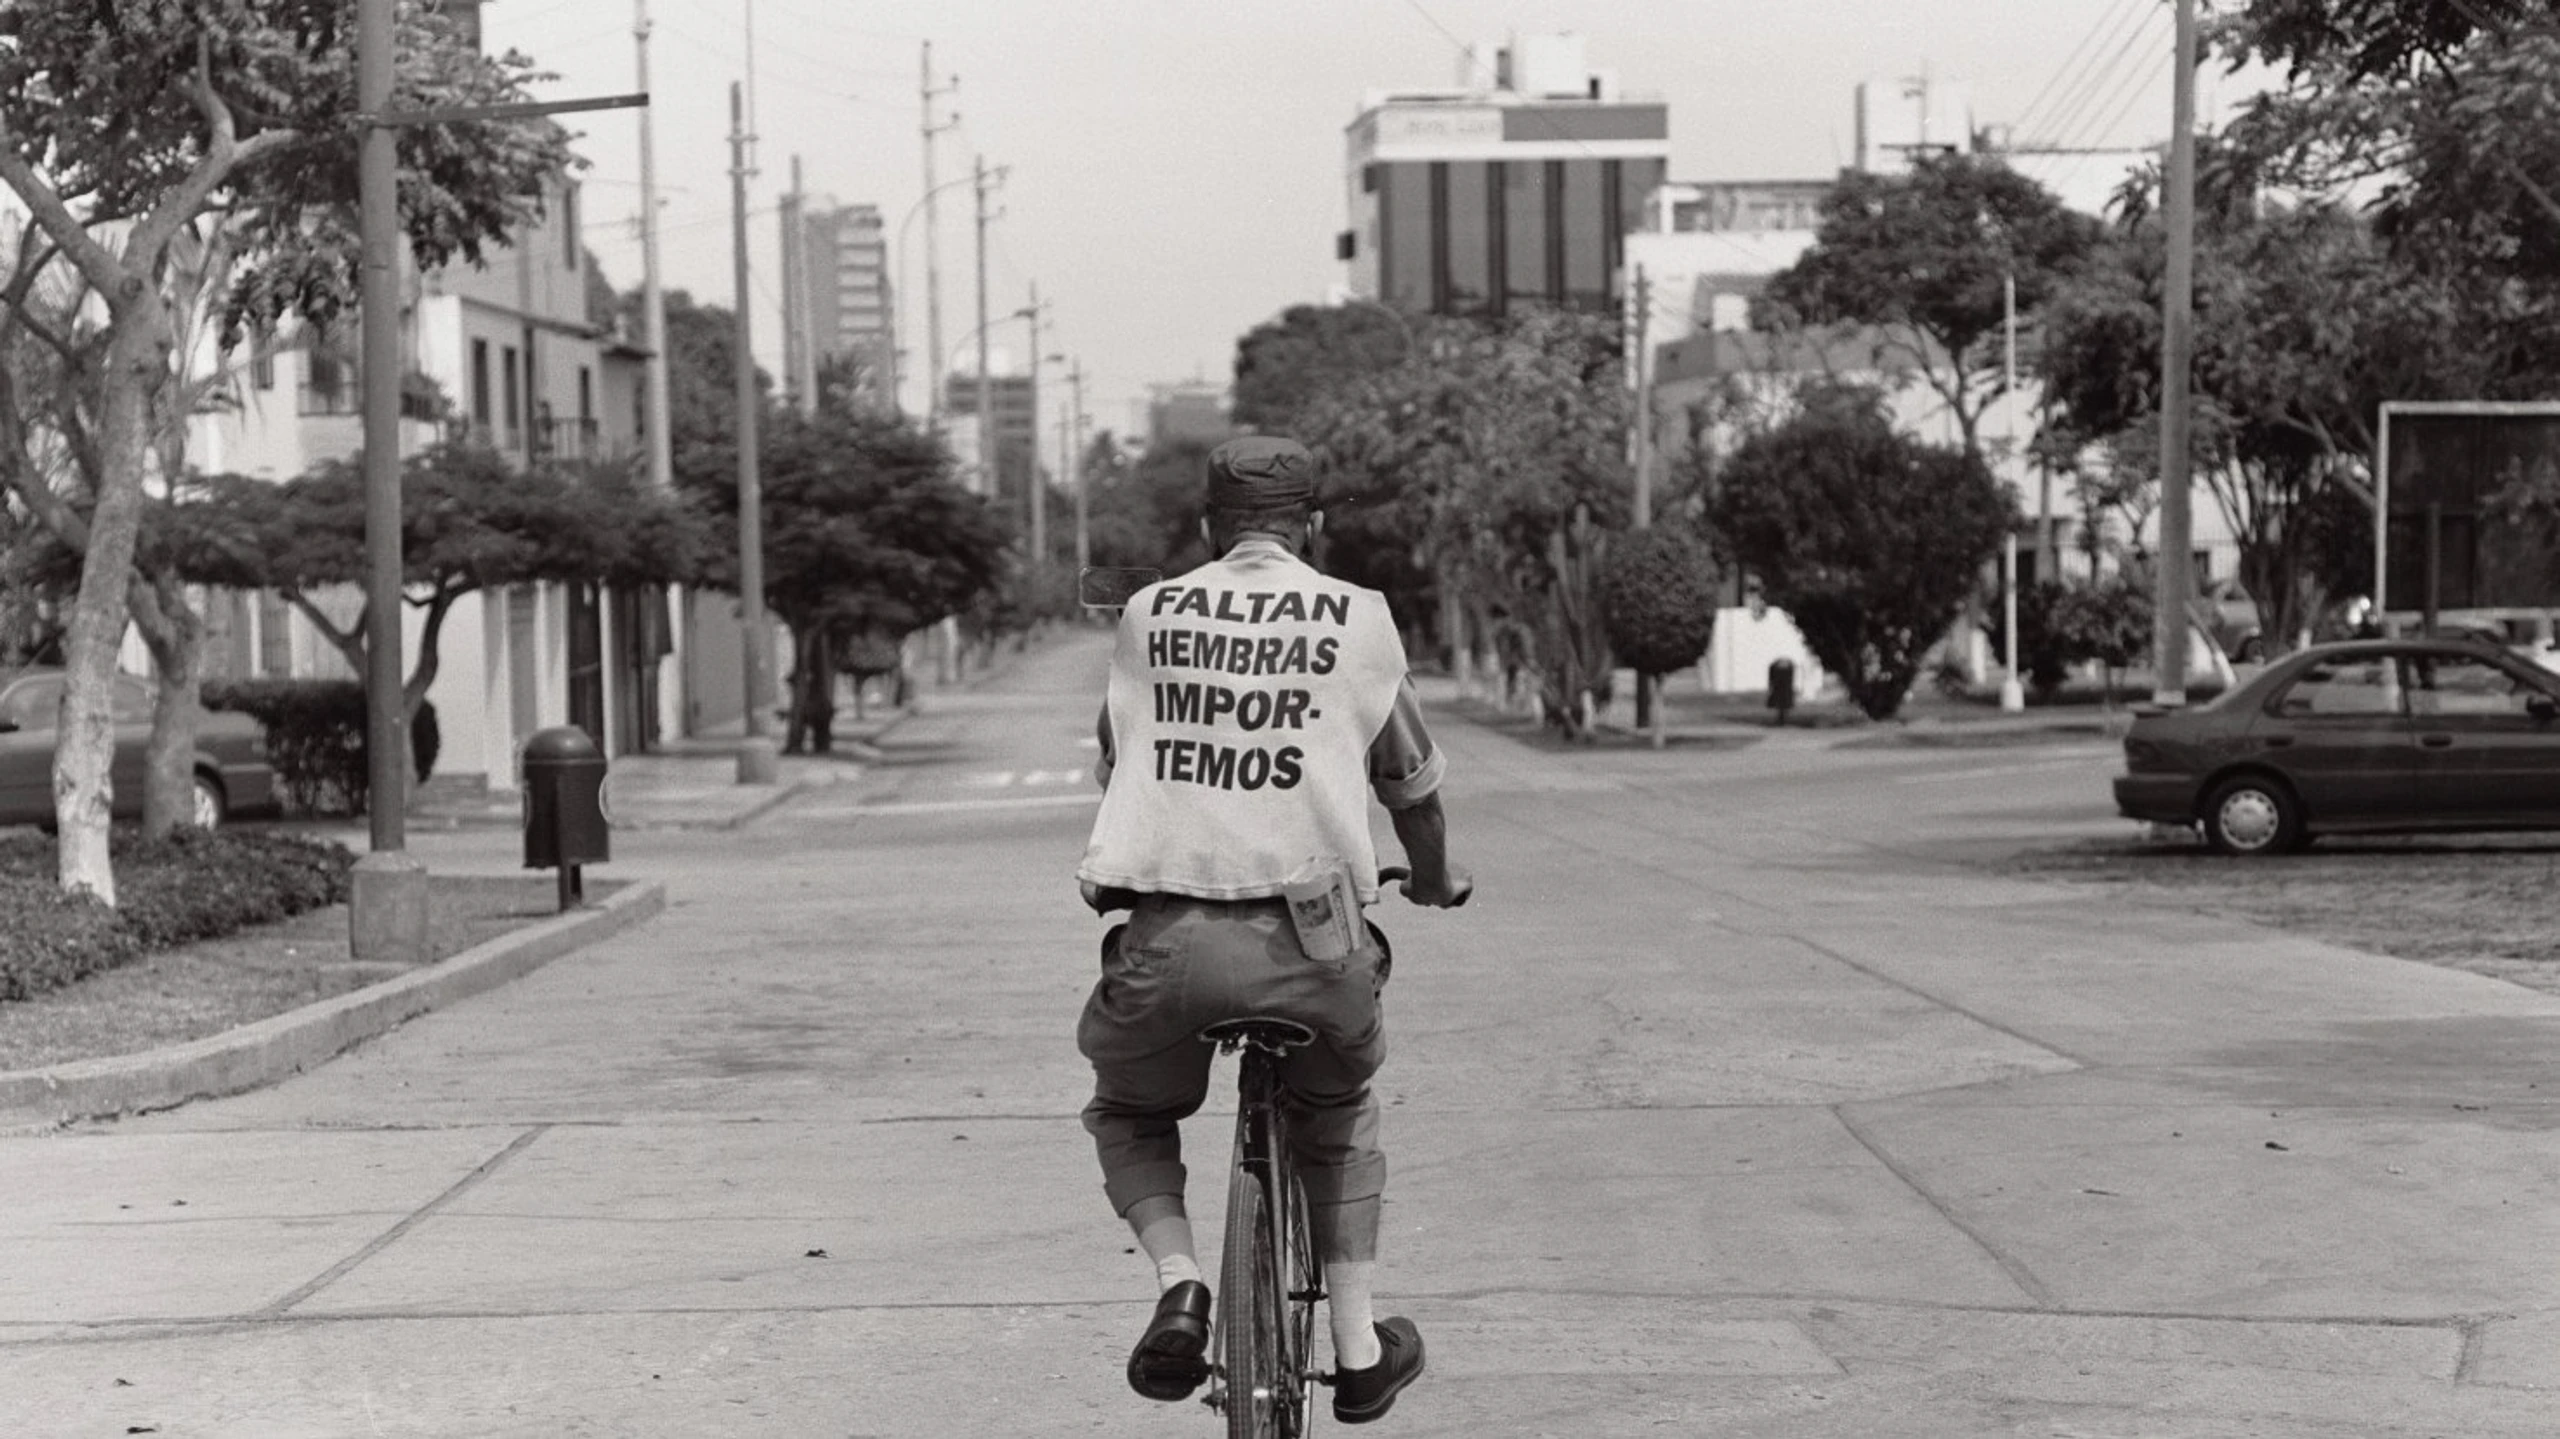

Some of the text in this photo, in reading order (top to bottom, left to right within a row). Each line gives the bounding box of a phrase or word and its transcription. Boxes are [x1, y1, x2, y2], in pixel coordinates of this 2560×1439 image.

[1150, 585, 1351, 627] FALTAN
[1148, 629, 1340, 676] HEMBRAS
[1153, 682, 1321, 732] IMPOR-
[1153, 738, 1305, 791] TEMOS
